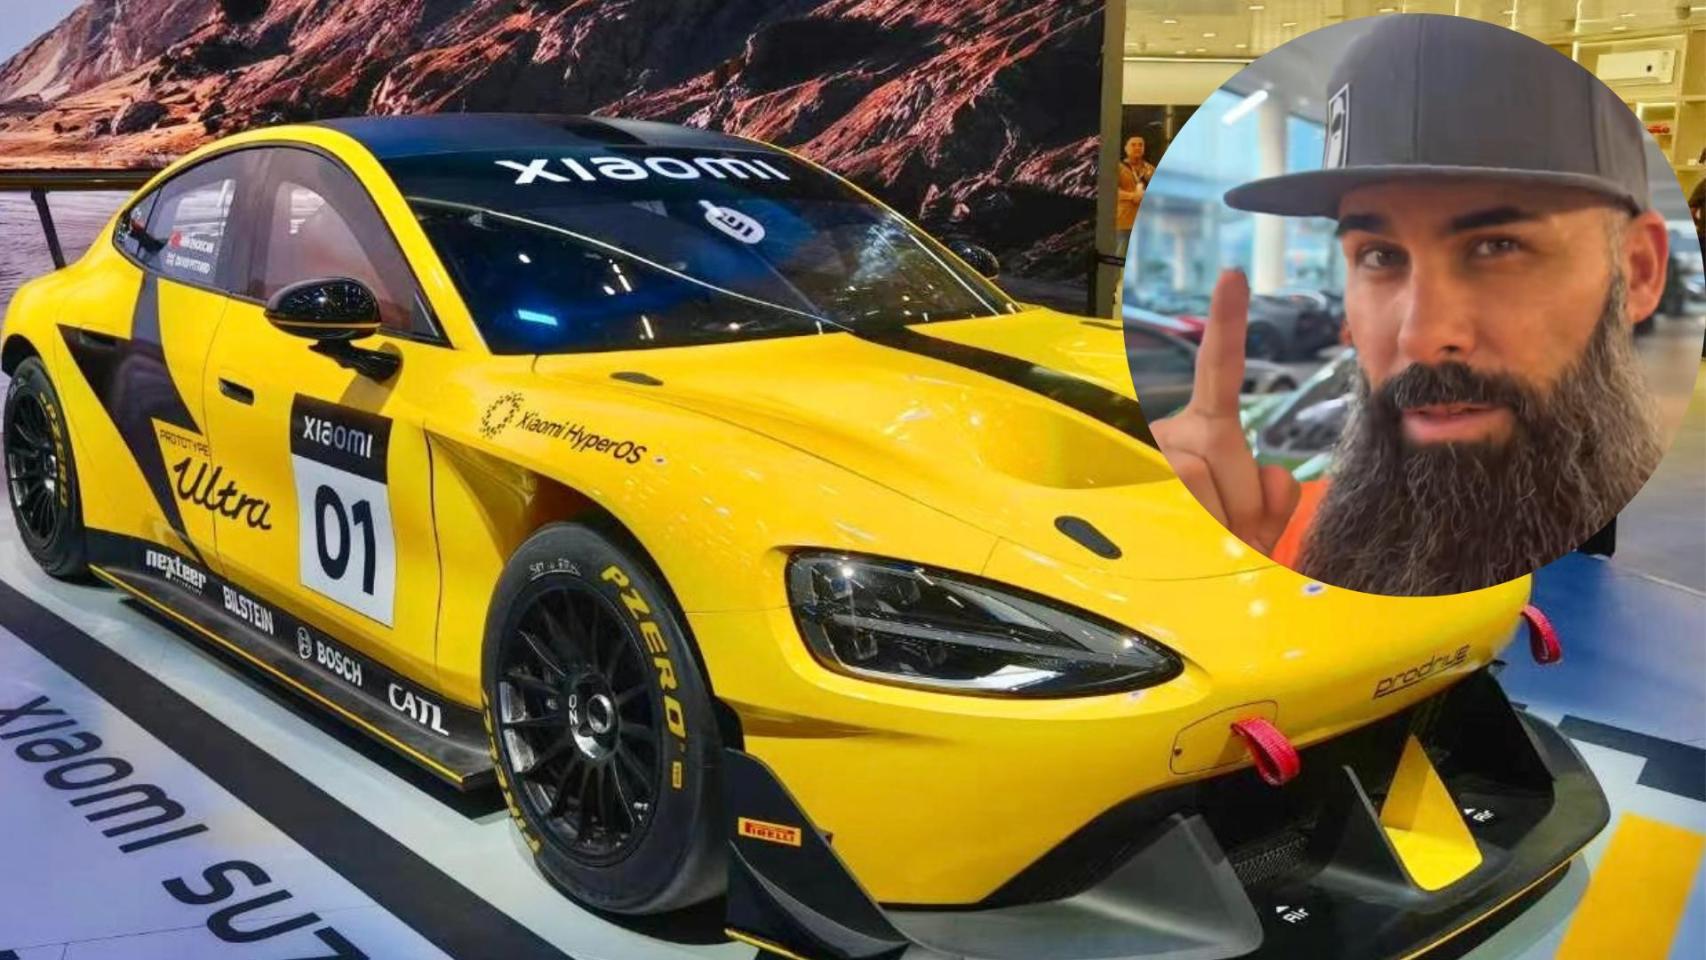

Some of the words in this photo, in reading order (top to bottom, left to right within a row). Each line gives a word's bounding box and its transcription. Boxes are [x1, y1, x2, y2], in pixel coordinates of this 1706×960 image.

[516, 410, 569, 438] Xiaomi
[563, 423, 648, 464] HyperOS
[173, 456, 272, 530] Ultra
[305, 484, 376, 596] 01
[145, 549, 207, 589] nexteer
[222, 584, 274, 636] BILSTEIN
[316, 640, 363, 687] BOSCH
[387, 683, 449, 737] CATL
